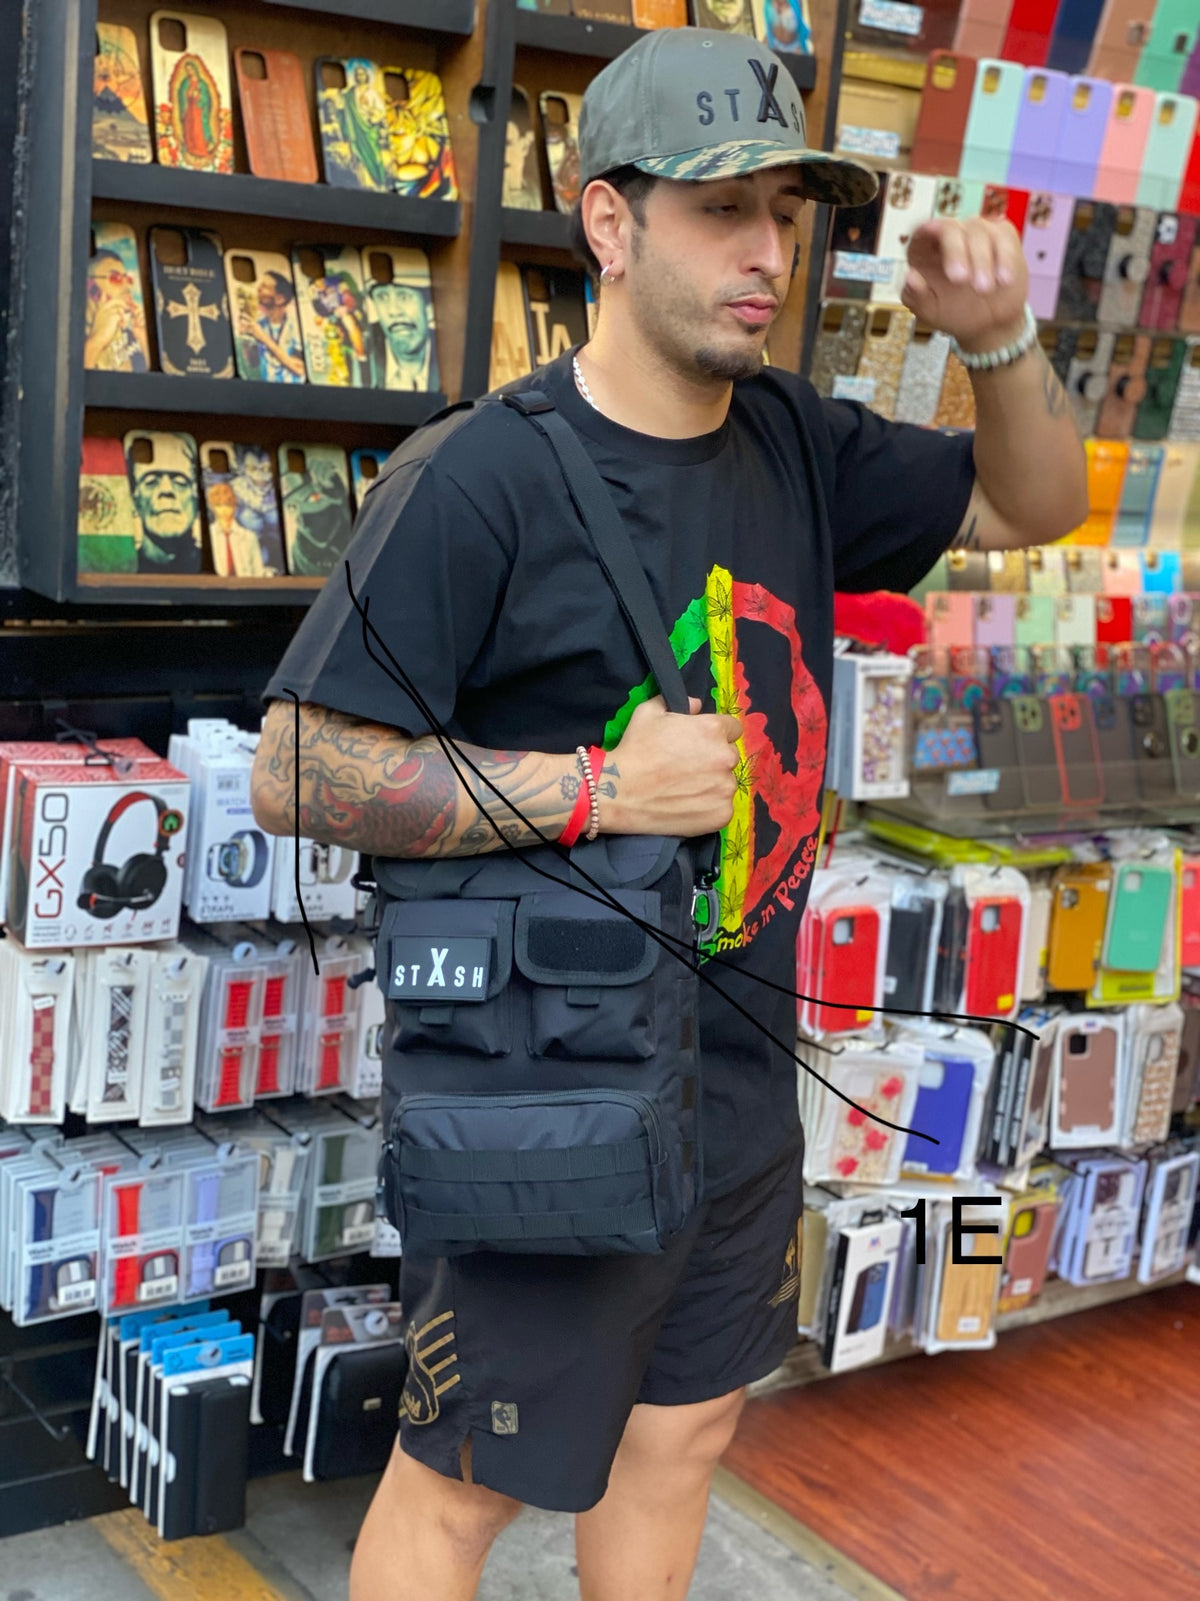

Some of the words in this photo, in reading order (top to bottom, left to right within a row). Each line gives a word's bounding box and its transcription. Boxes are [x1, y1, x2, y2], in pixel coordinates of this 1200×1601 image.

[34, 792, 69, 919] GX50
[700, 921, 759, 965] Smoke
[761, 903, 776, 928] in
[773, 836, 818, 911] Peace
[394, 947, 484, 988] STASH
